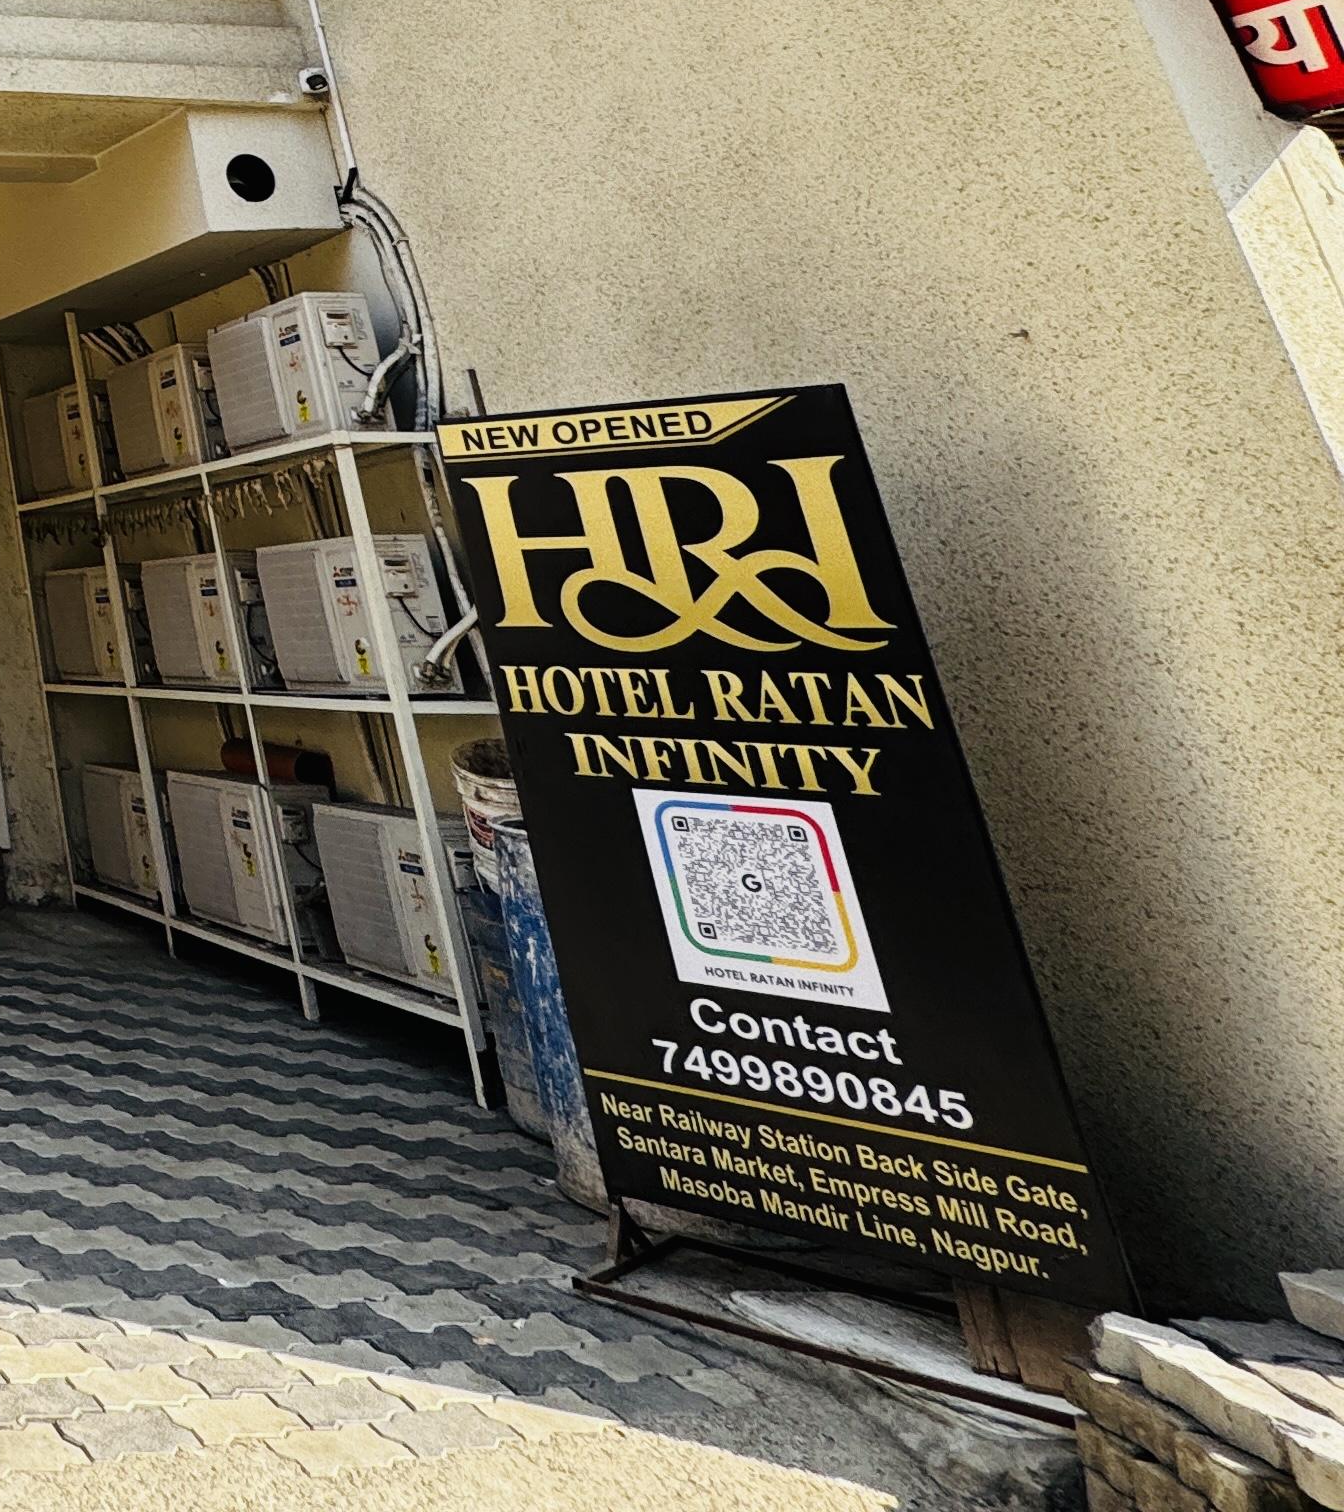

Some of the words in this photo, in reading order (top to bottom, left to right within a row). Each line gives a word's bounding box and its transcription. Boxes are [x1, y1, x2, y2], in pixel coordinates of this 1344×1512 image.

[462, 424, 540, 452] NEW
[552, 410, 713, 445] OPENED
[499, 665, 695, 720] HOTEL
[701, 669, 936, 730] RATAN
[565, 732, 882, 796] INFINITY
[741, 873, 762, 893] G
[705, 966, 747, 982] HOTEL
[750, 972, 794, 989] RATAN
[797, 979, 854, 997] INFINITY
[690, 998, 903, 1065] Contact
[651, 1038, 974, 1130] 7499890845
[600, 1092, 653, 1124] Near
[661, 1100, 752, 1149] Railway
[759, 1124, 850, 1166] Station
[855, 1144, 926, 1182] Back
[934, 1159, 998, 1196] Side
[1006, 1175, 1089, 1219] Gate,
[616, 1126, 707, 1167] Santara
[711, 1148, 806, 1192] Market,
[810, 1169, 930, 1216] Empress
[936, 1193, 991, 1229] Mill
[996, 1207, 1089, 1254] Road,
[660, 1165, 754, 1210] Masoba
[761, 1192, 850, 1232] Mandir
[856, 1210, 927, 1253] Line,
[931, 1227, 1050, 1279] Nagpur.
